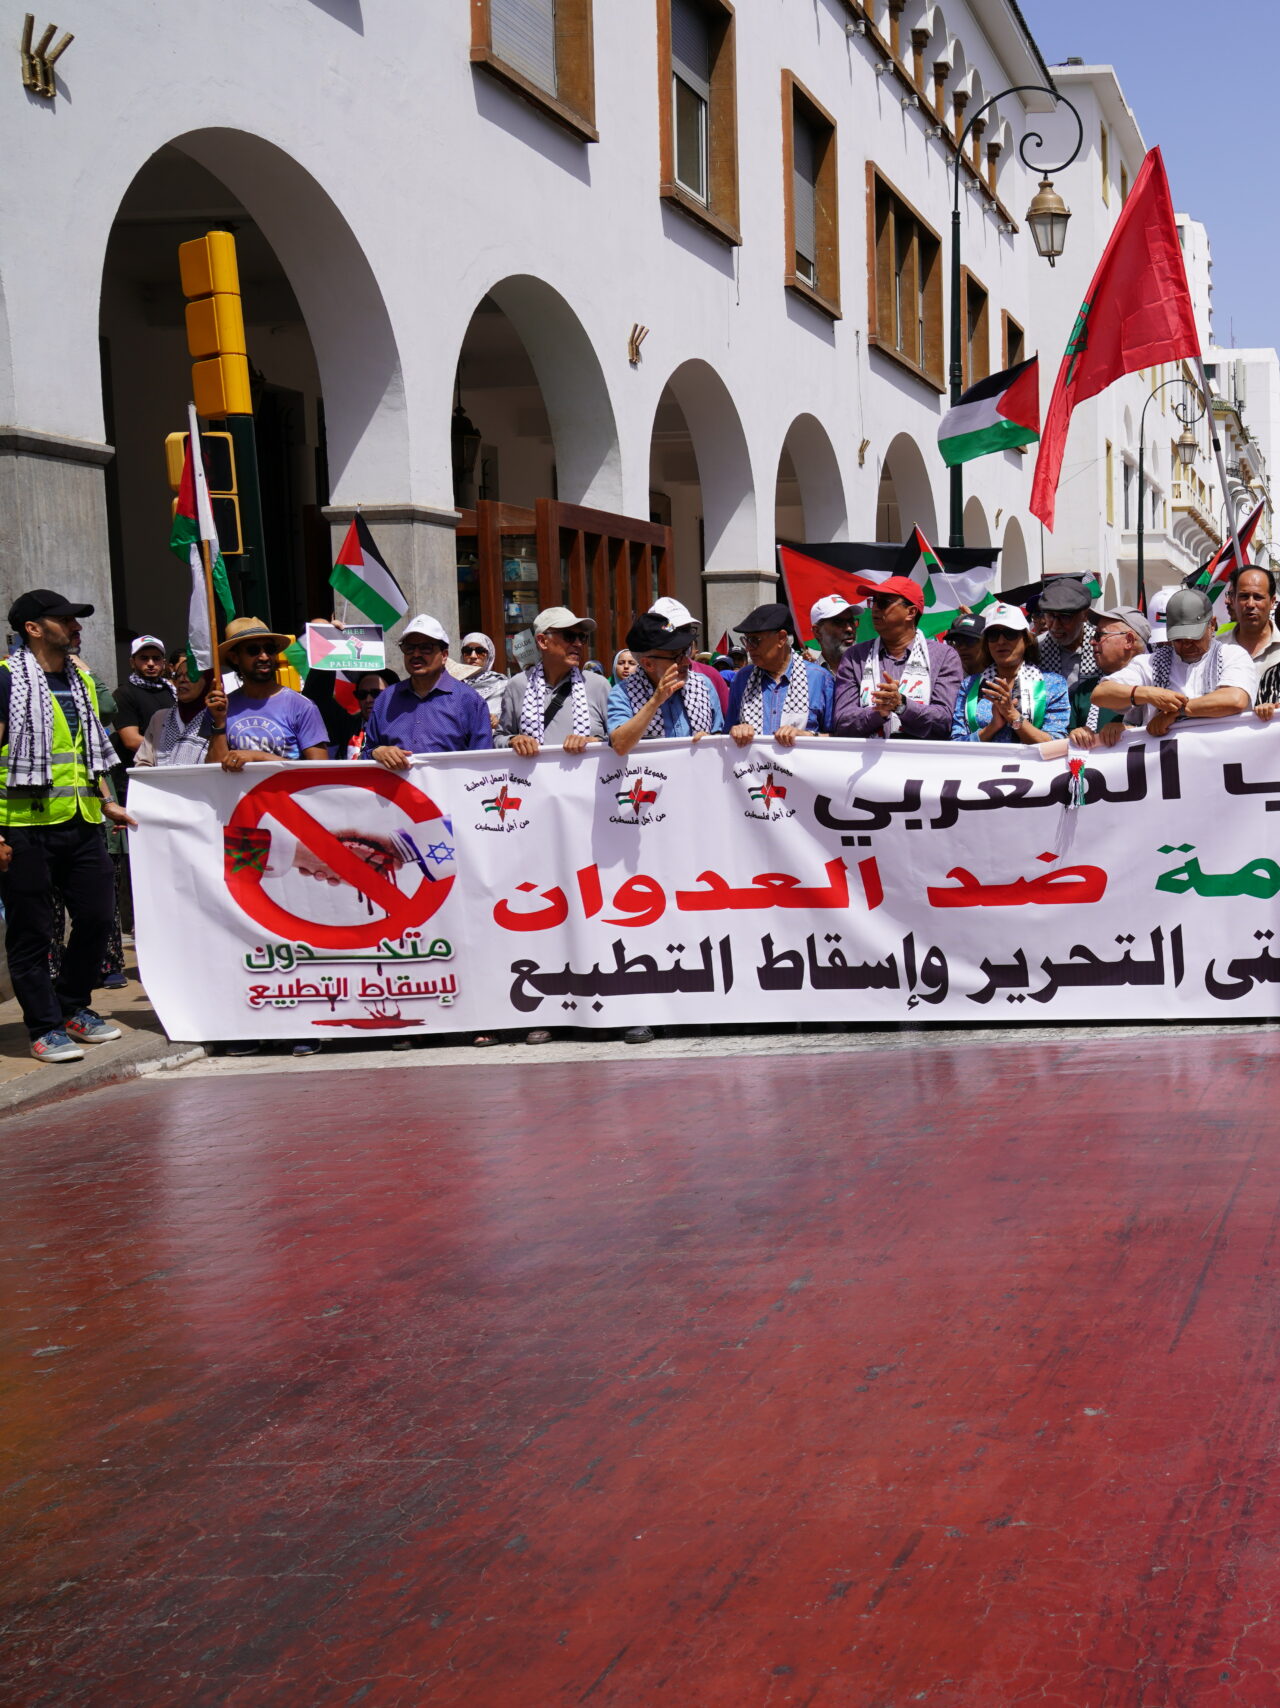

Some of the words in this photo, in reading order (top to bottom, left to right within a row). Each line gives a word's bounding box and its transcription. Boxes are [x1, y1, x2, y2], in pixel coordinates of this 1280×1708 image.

[330, 661, 379, 669] PALESTINE
[235, 718, 277, 732] MIAMI
[489, 773, 508, 785] العمل
[624, 766, 642, 778] العمل
[643, 766, 668, 781] مجموعة
[464, 776, 489, 792] الوطنية
[509, 773, 532, 787] مجموعة
[814, 739, 1181, 846] المغربي
[519, 819, 530, 829] من
[609, 815, 639, 825] فلسطين
[655, 813, 667, 822] من
[474, 823, 505, 832] فلسطين
[927, 851, 1108, 908] ضد
[493, 857, 884, 932] العدوان
[244, 931, 453, 969] متحدون
[757, 931, 949, 1010] وإسقاط
[966, 923, 1184, 1004] التحرير
[509, 934, 733, 1013] التطبيع
[248, 976, 348, 1005] التطبيع
[357, 973, 458, 1004] لإسقاط
